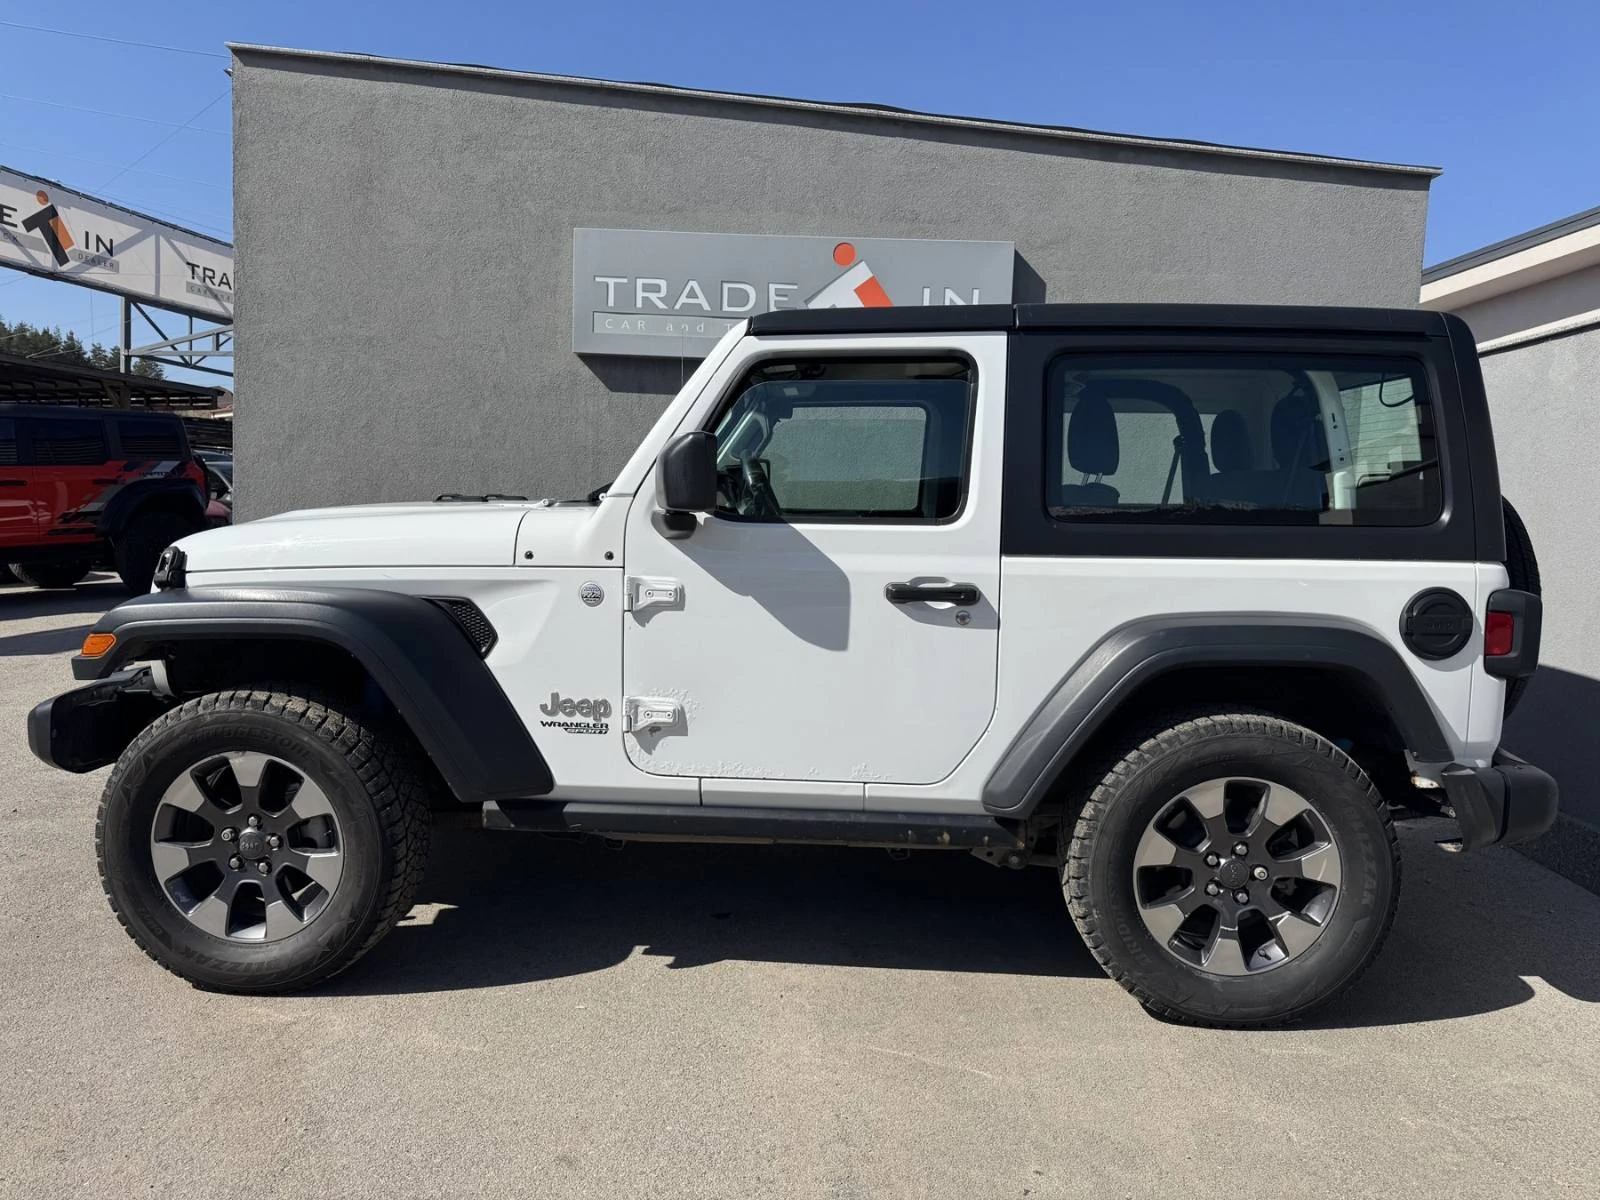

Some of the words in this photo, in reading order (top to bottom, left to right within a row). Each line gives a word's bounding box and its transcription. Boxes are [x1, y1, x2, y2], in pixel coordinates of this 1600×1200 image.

[85, 230, 114, 257] IN
[186, 261, 233, 291] TRA
[594, 276, 798, 312] TRADE
[605, 318, 646, 331] CAR
[665, 321, 705, 333] and
[540, 692, 612, 722] Jeep
[540, 720, 609, 729] WRANGLER
